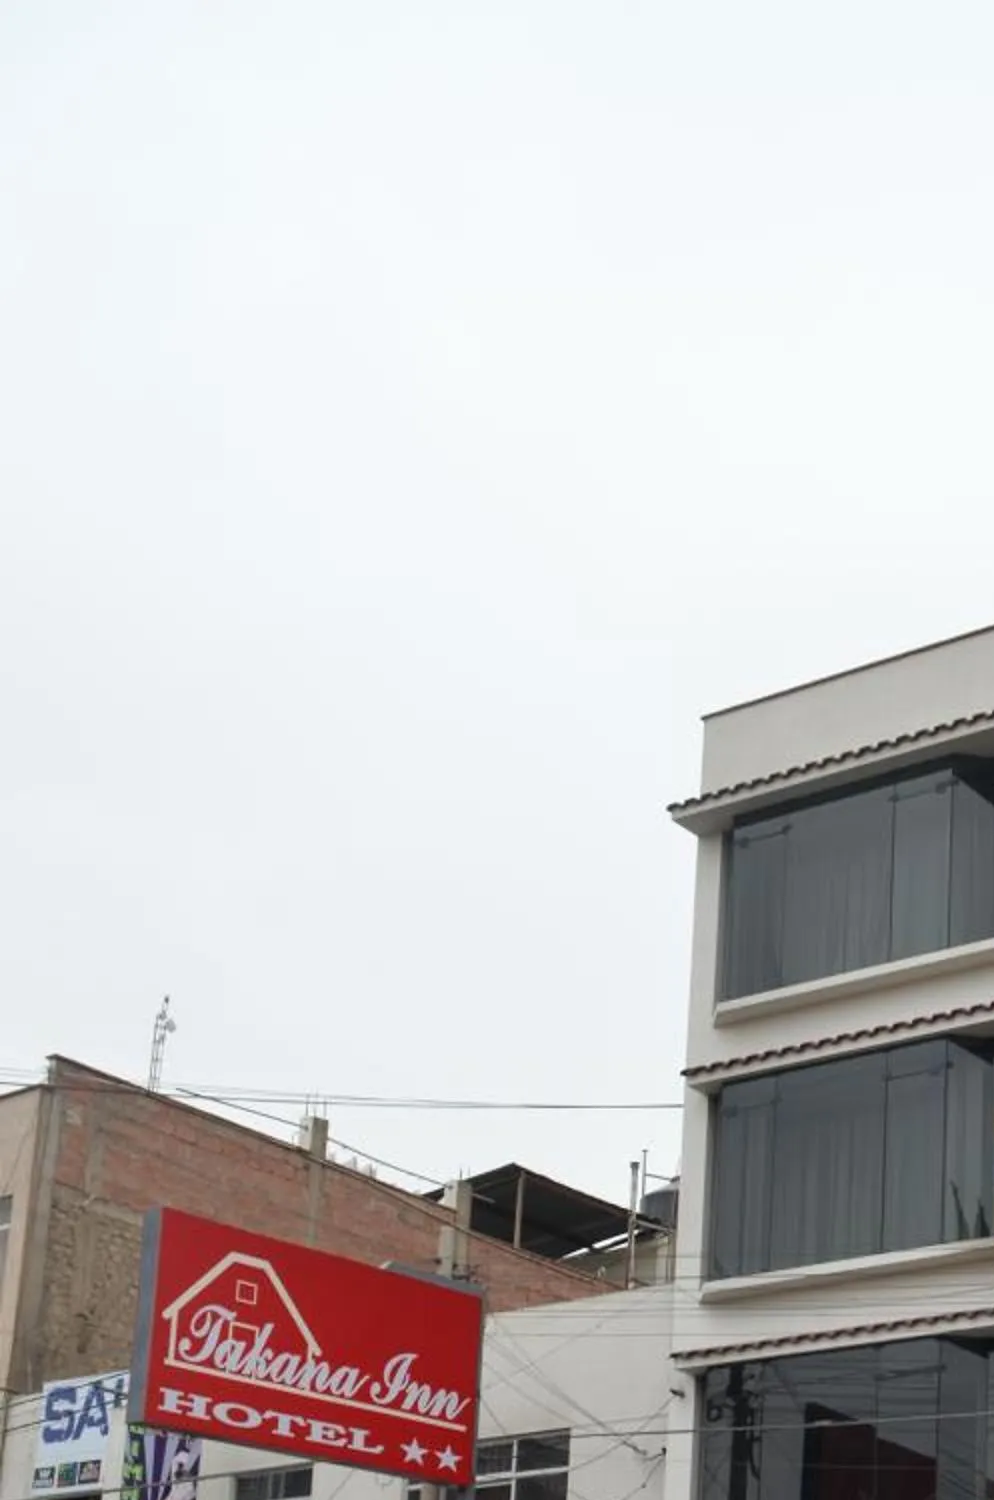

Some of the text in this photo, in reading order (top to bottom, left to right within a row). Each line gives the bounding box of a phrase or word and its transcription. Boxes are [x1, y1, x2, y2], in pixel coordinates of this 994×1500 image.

[178, 1304, 471, 1421] Takana Inn
[158, 1386, 384, 1455] HOTEL
